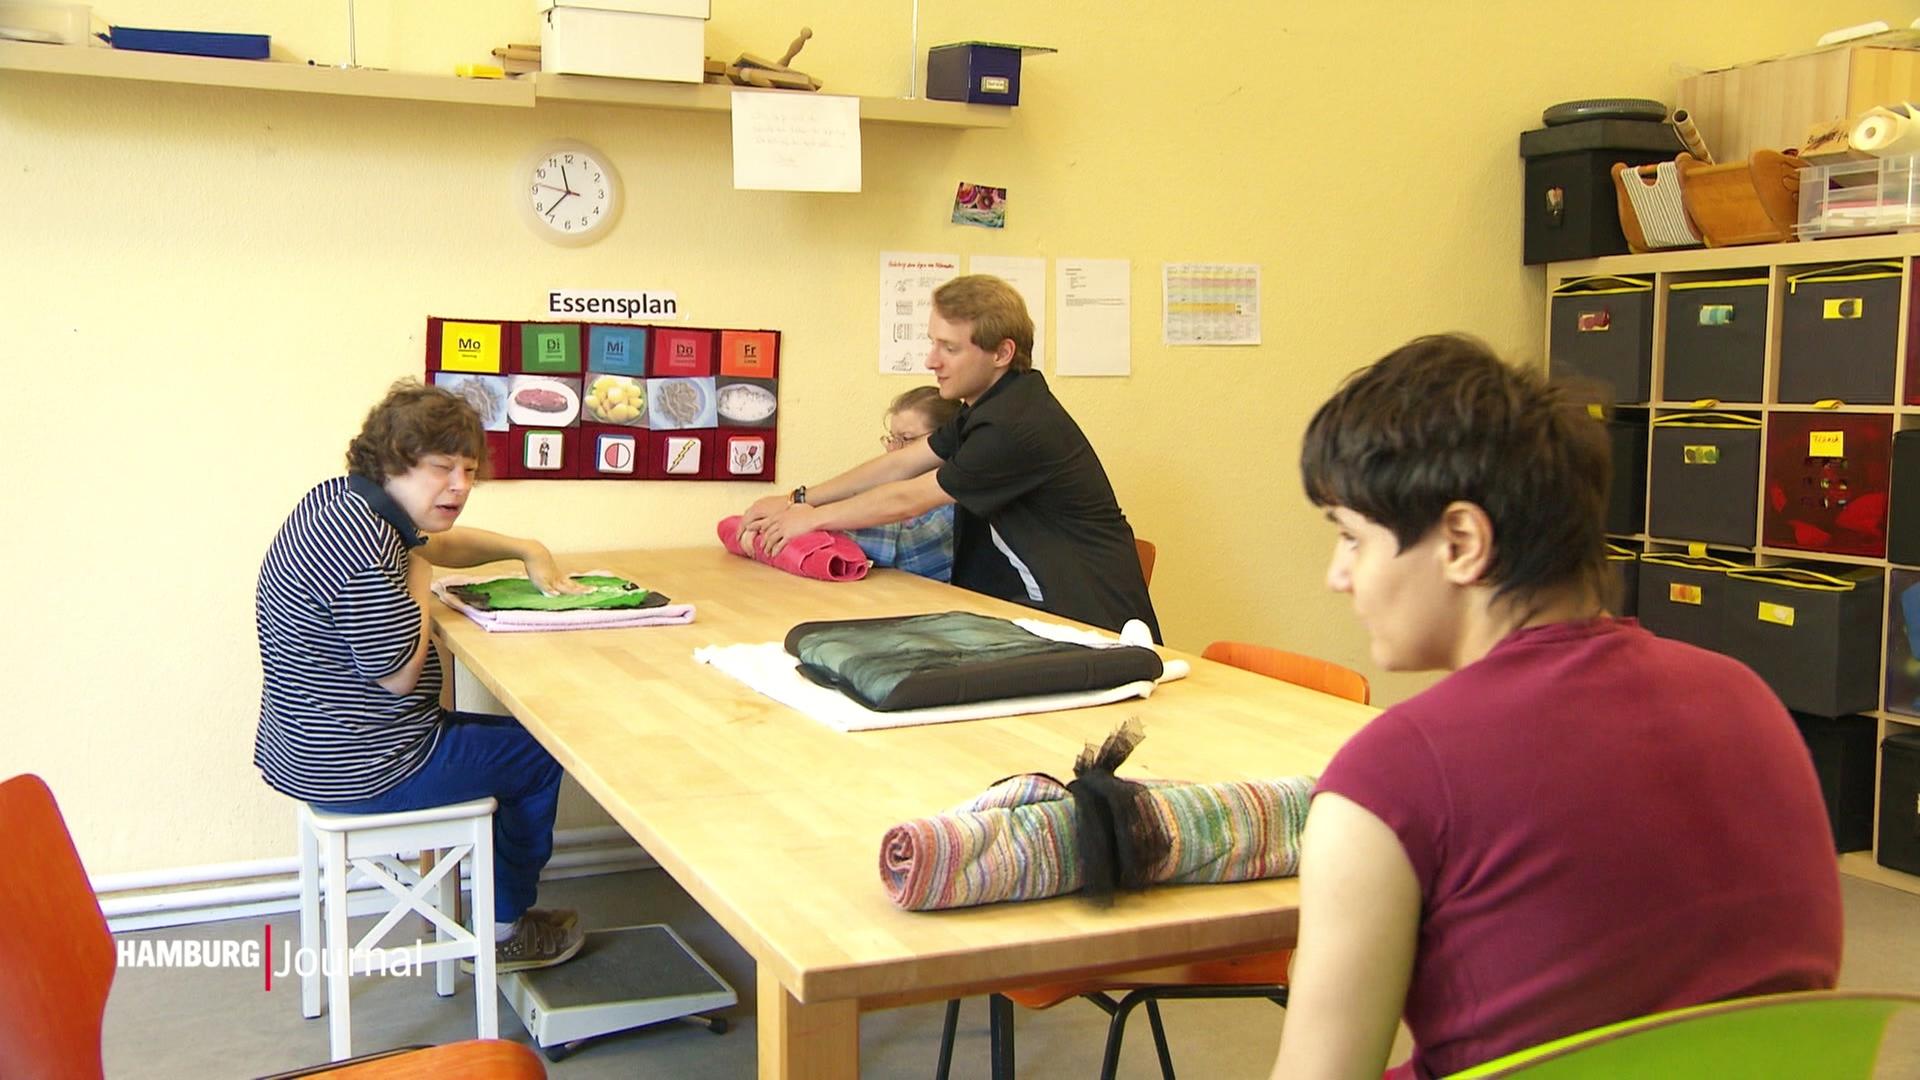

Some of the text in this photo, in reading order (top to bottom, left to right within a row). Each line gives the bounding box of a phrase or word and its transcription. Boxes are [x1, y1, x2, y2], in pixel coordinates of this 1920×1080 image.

[548, 158, 557, 168] 11
[564, 154, 574, 164] 12
[583, 160, 587, 169] 1
[536, 169, 546, 179] 10
[594, 173, 600, 182] 2
[532, 185, 538, 195] 9
[598, 190, 604, 199] 3
[536, 202, 543, 211] 8
[593, 206, 599, 215] 4
[549, 214, 555, 224] 7
[581, 217, 588, 226] 5
[564, 221, 571, 230] 6
[549, 292, 677, 318] Essensplan
[458, 338, 481, 350] Mo
[546, 338, 560, 350] Di
[607, 341, 624, 354] Mi
[676, 344, 694, 355] Do
[744, 344, 757, 355] Fr
